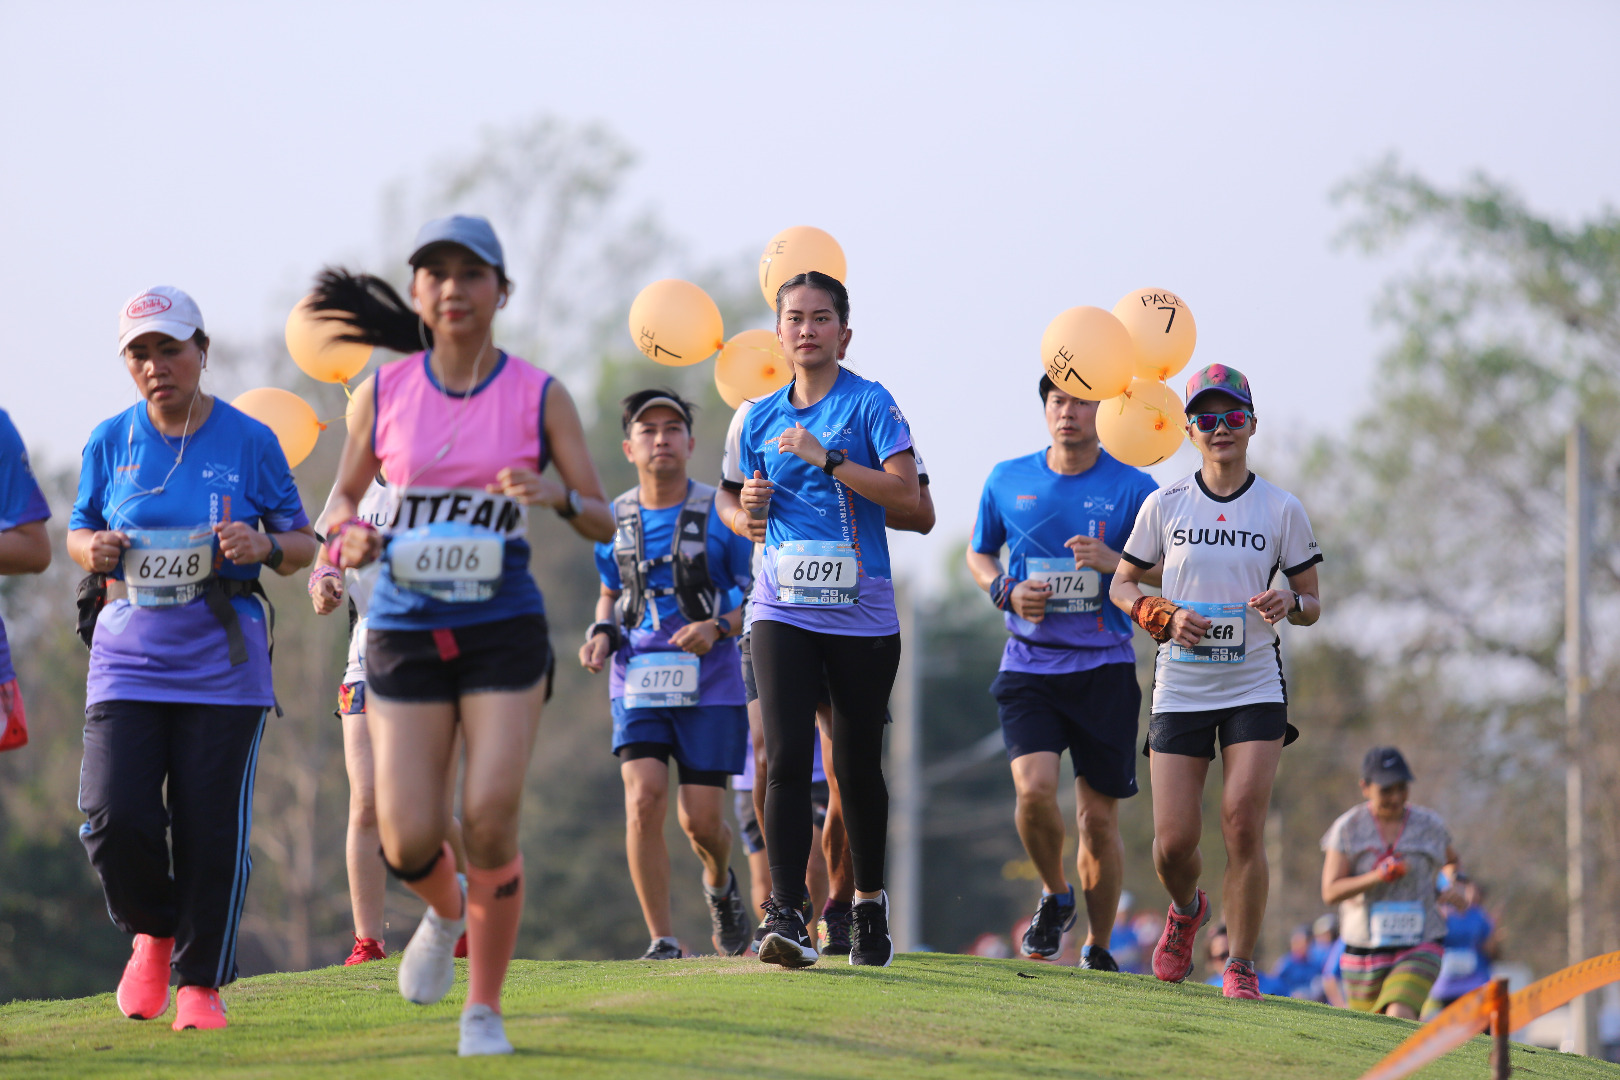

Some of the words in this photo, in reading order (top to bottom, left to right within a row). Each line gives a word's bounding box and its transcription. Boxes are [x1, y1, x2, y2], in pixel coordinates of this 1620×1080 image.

[1141, 293, 1184, 308] PACE
[1157, 306, 1176, 334] 7
[654, 344, 682, 359] 7
[1047, 345, 1074, 384] PACE
[1064, 367, 1092, 391] 7
[834, 482, 848, 526] COUNTRY
[1173, 528, 1266, 552] SUUNTO
[139, 553, 200, 579] 6248
[416, 546, 480, 572] 6106
[793, 560, 842, 582] 6091
[1230, 652, 1239, 661] 16
[641, 670, 684, 688] 6170
